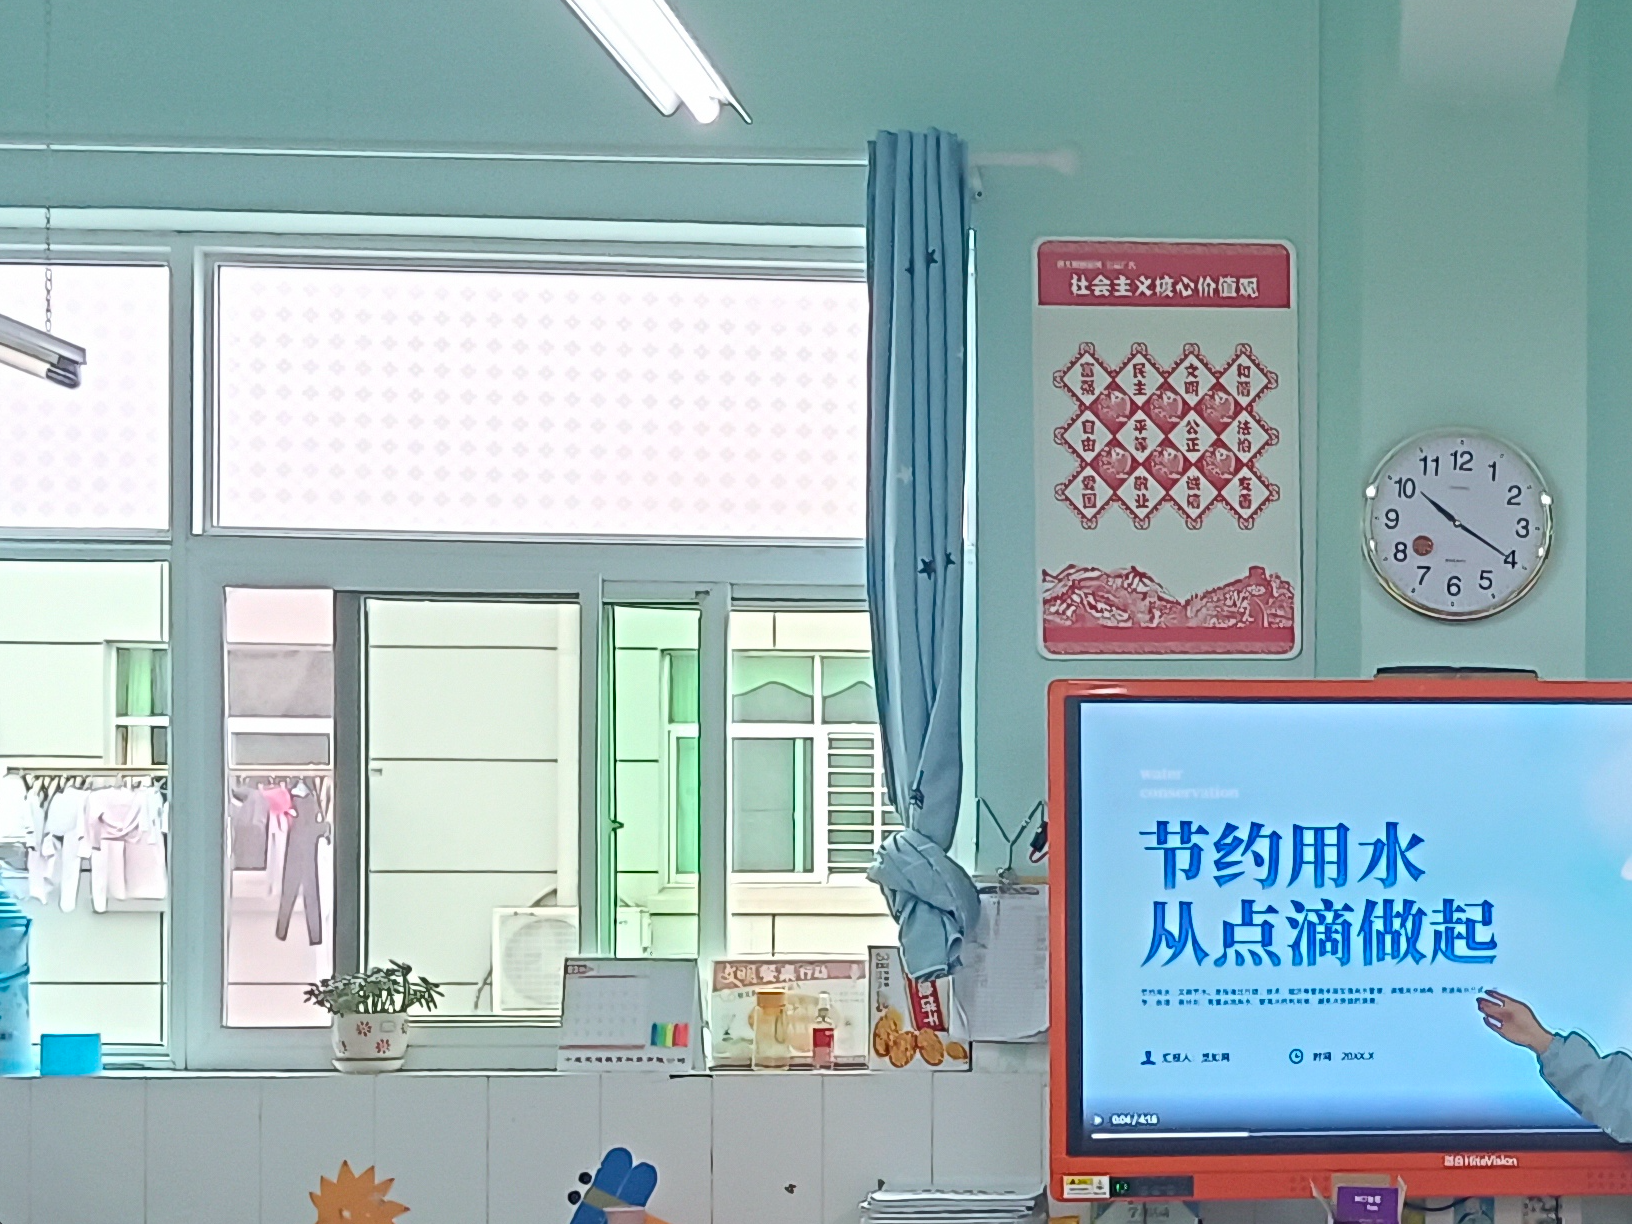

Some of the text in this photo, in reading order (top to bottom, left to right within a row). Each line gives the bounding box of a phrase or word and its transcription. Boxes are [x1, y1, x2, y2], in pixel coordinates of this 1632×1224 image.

[1071, 274, 1259, 298] 社会主义核心价值观
[1080, 362, 1095, 396] 富强
[1132, 363, 1147, 396] 民主
[1184, 363, 1200, 396] 文明
[1236, 364, 1251, 397] 和谐
[1081, 420, 1096, 452] 自由
[1133, 419, 1148, 453] 平等
[1185, 419, 1200, 452] 公正
[1237, 420, 1251, 453] 法治
[1419, 455, 1440, 476] 11
[1450, 450, 1474, 471] 12
[1488, 461, 1497, 482] 1
[1081, 475, 1097, 509] 爱国
[1134, 475, 1149, 509] 敬业
[1186, 476, 1200, 509] 诚信
[1238, 476, 1252, 509] 友善
[1394, 477, 1416, 499] 10
[1507, 485, 1522, 506] 2
[1385, 508, 1399, 529] 9
[1515, 518, 1530, 538] 3
[1394, 541, 1407, 562] 8
[1504, 550, 1517, 569] 4
[1416, 565, 1431, 585] 7
[1446, 576, 1462, 596] 6
[1478, 570, 1493, 590] 5
[1139, 820, 1426, 890] 节约用水
[1140, 898, 1497, 968] 从点滴做起
